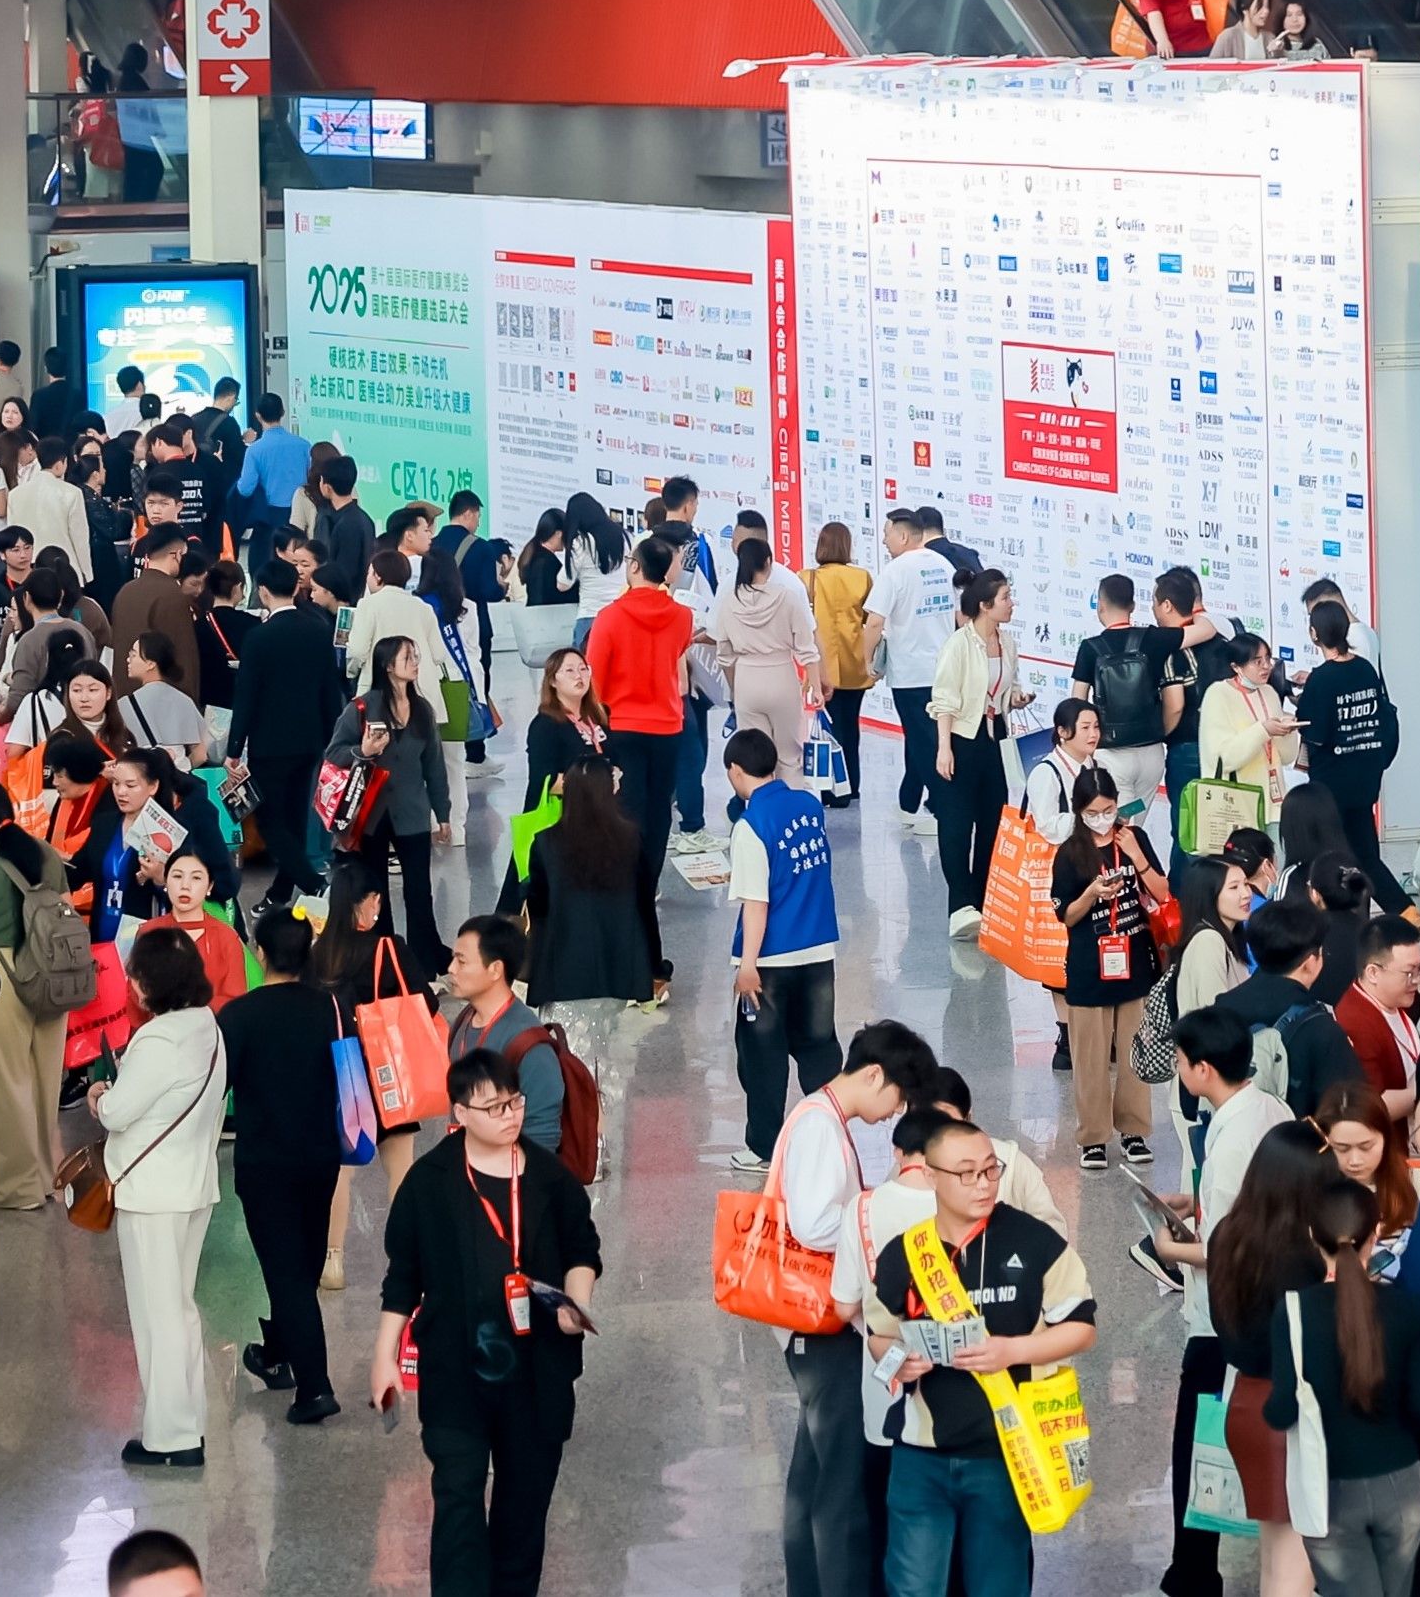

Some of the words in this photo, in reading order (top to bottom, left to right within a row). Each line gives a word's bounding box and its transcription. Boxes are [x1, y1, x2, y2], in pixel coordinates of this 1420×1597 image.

[308, 263, 368, 319] 2025
[371, 293, 470, 326] 国际医疗健康选品大会
[1197, 449, 1225, 463] ADSS
[1163, 527, 1190, 541] ADSS
